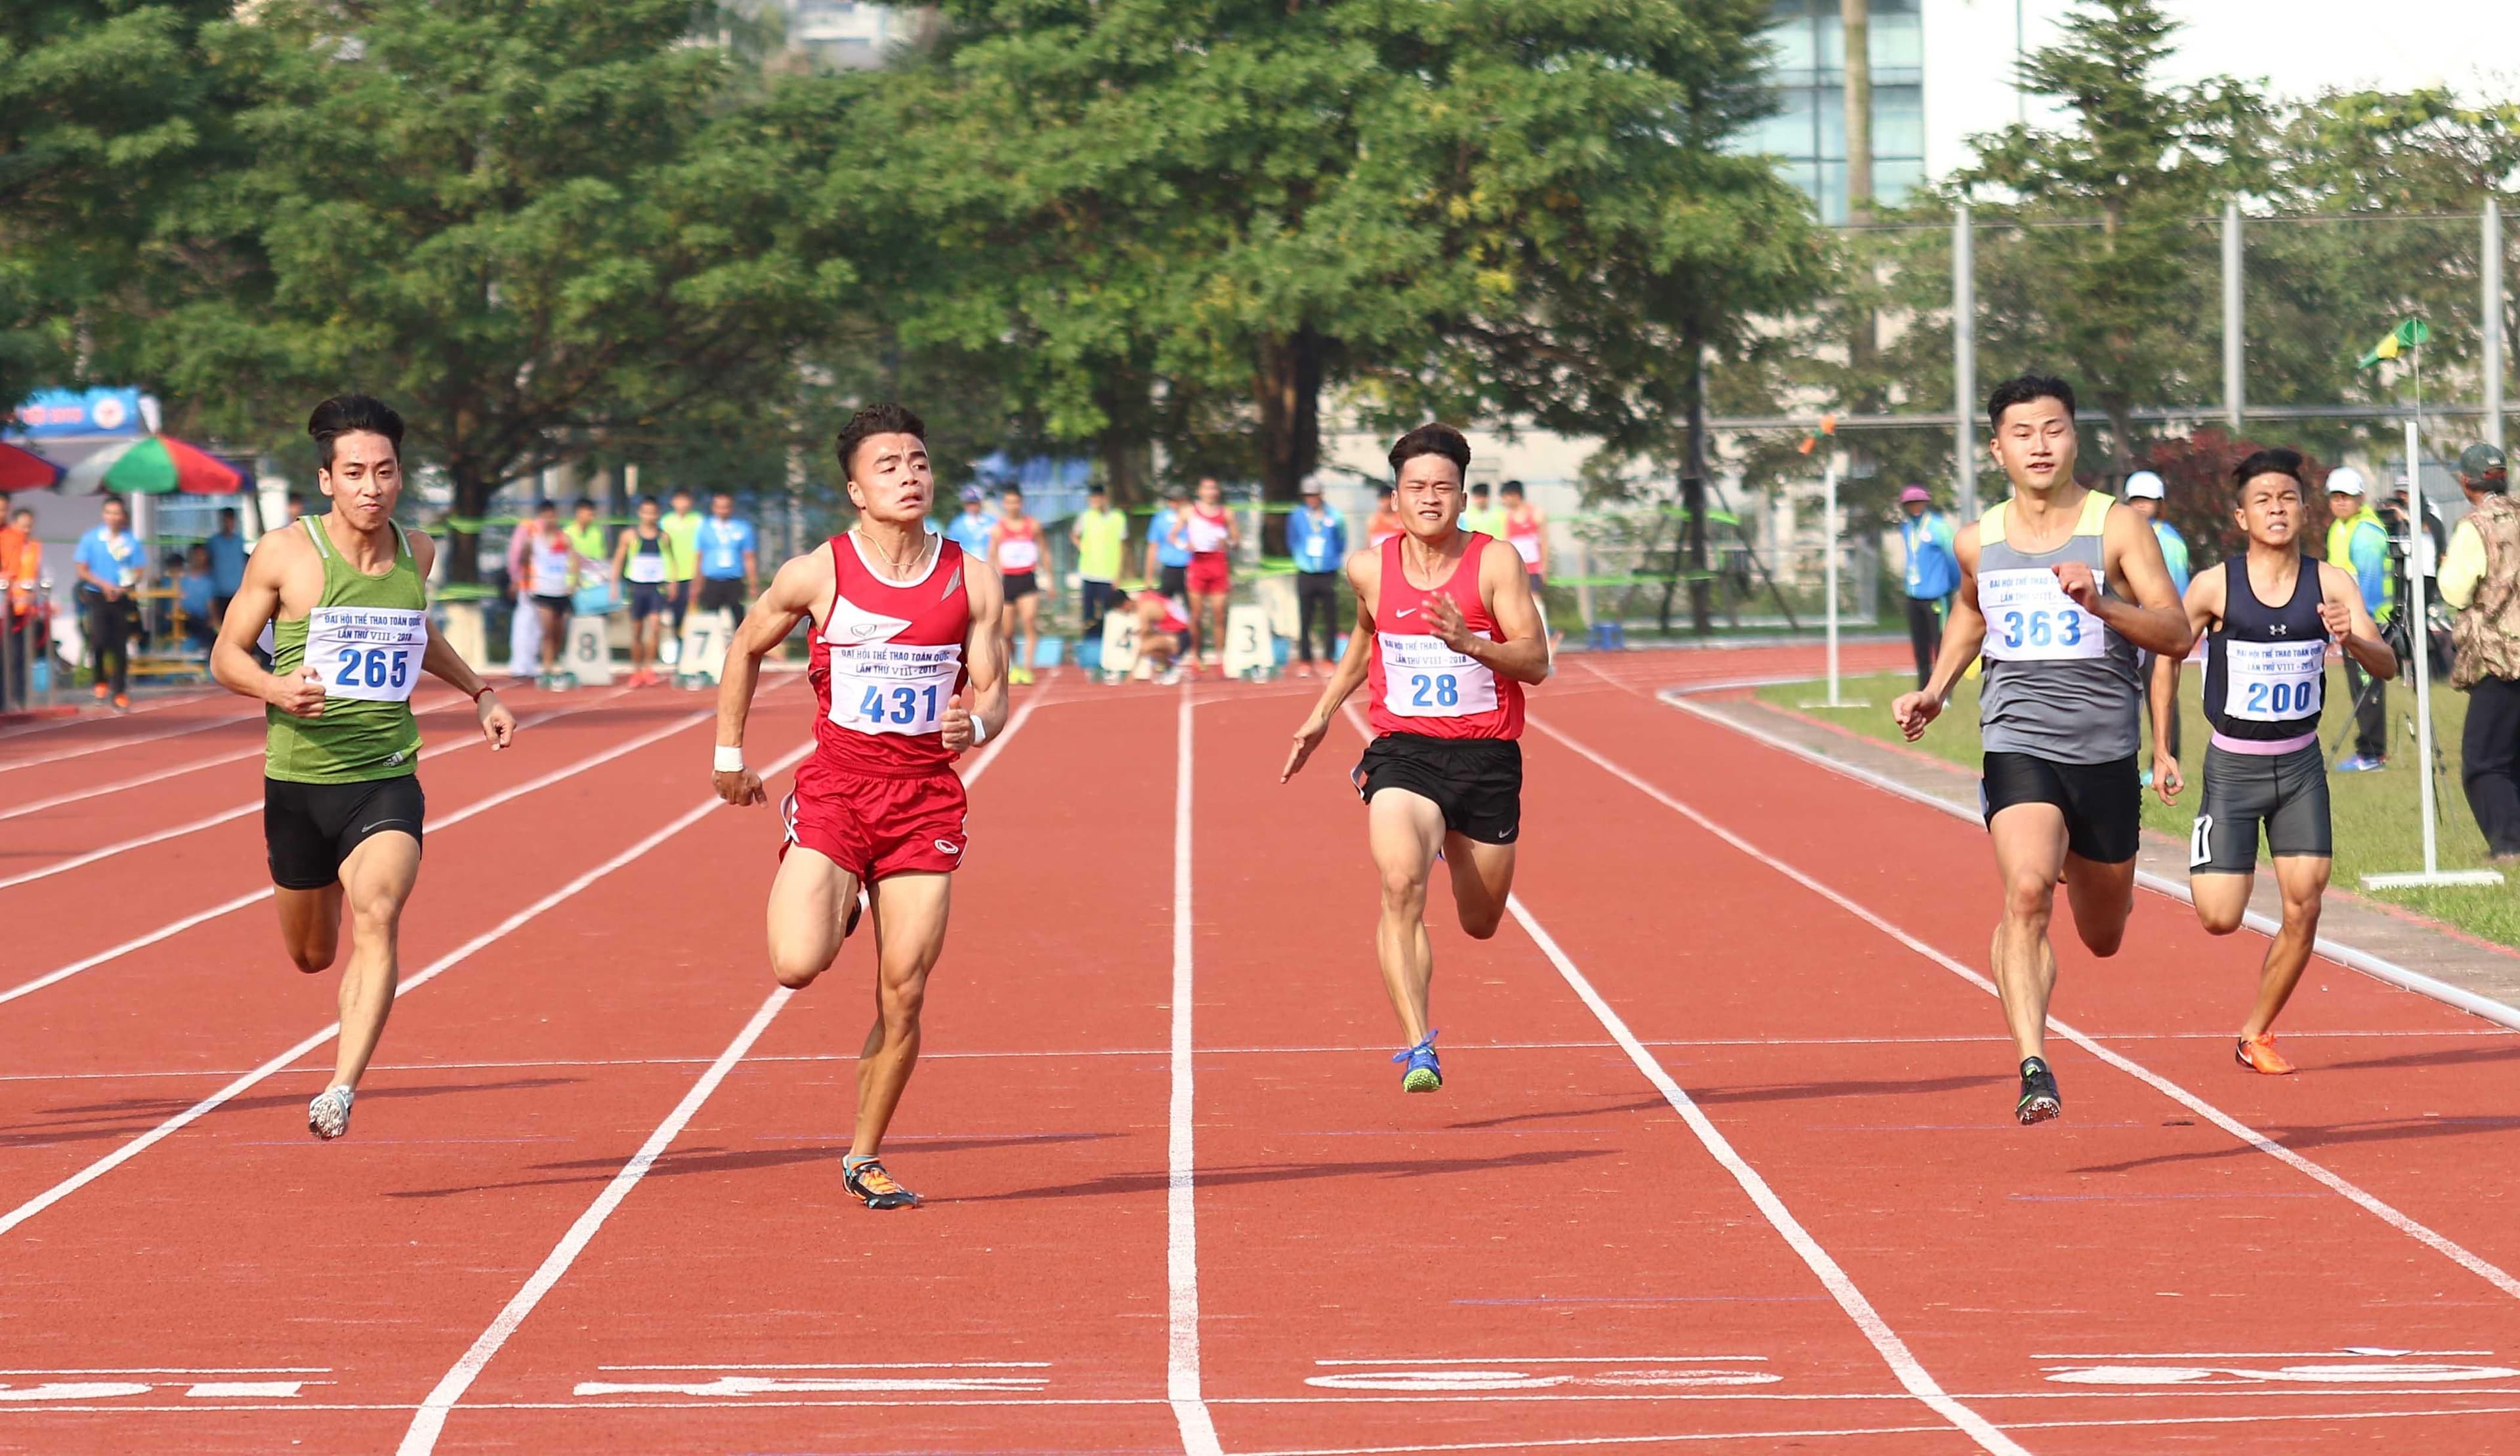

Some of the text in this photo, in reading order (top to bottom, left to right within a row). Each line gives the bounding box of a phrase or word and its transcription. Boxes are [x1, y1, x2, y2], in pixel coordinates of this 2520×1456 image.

[369, 615, 388, 625] THAO
[390, 615, 407, 627] TOÀN
[2004, 610, 2081, 648] 363
[370, 631, 390, 641] VIII
[397, 633, 412, 642] 2018
[579, 633, 598, 662] 8
[694, 629, 711, 658] 7
[1240, 625, 1256, 652] 3
[335, 648, 408, 688] 265
[889, 651, 909, 661] THAO
[912, 652, 933, 662] TOÀN
[892, 666, 912, 676] VIII
[919, 665, 937, 674] 2018
[1449, 655, 1467, 664] 2018
[860, 684, 937, 725] 431
[1412, 674, 1458, 707] 28
[2247, 682, 2311, 713] 200
[2198, 818, 2207, 859] 1
